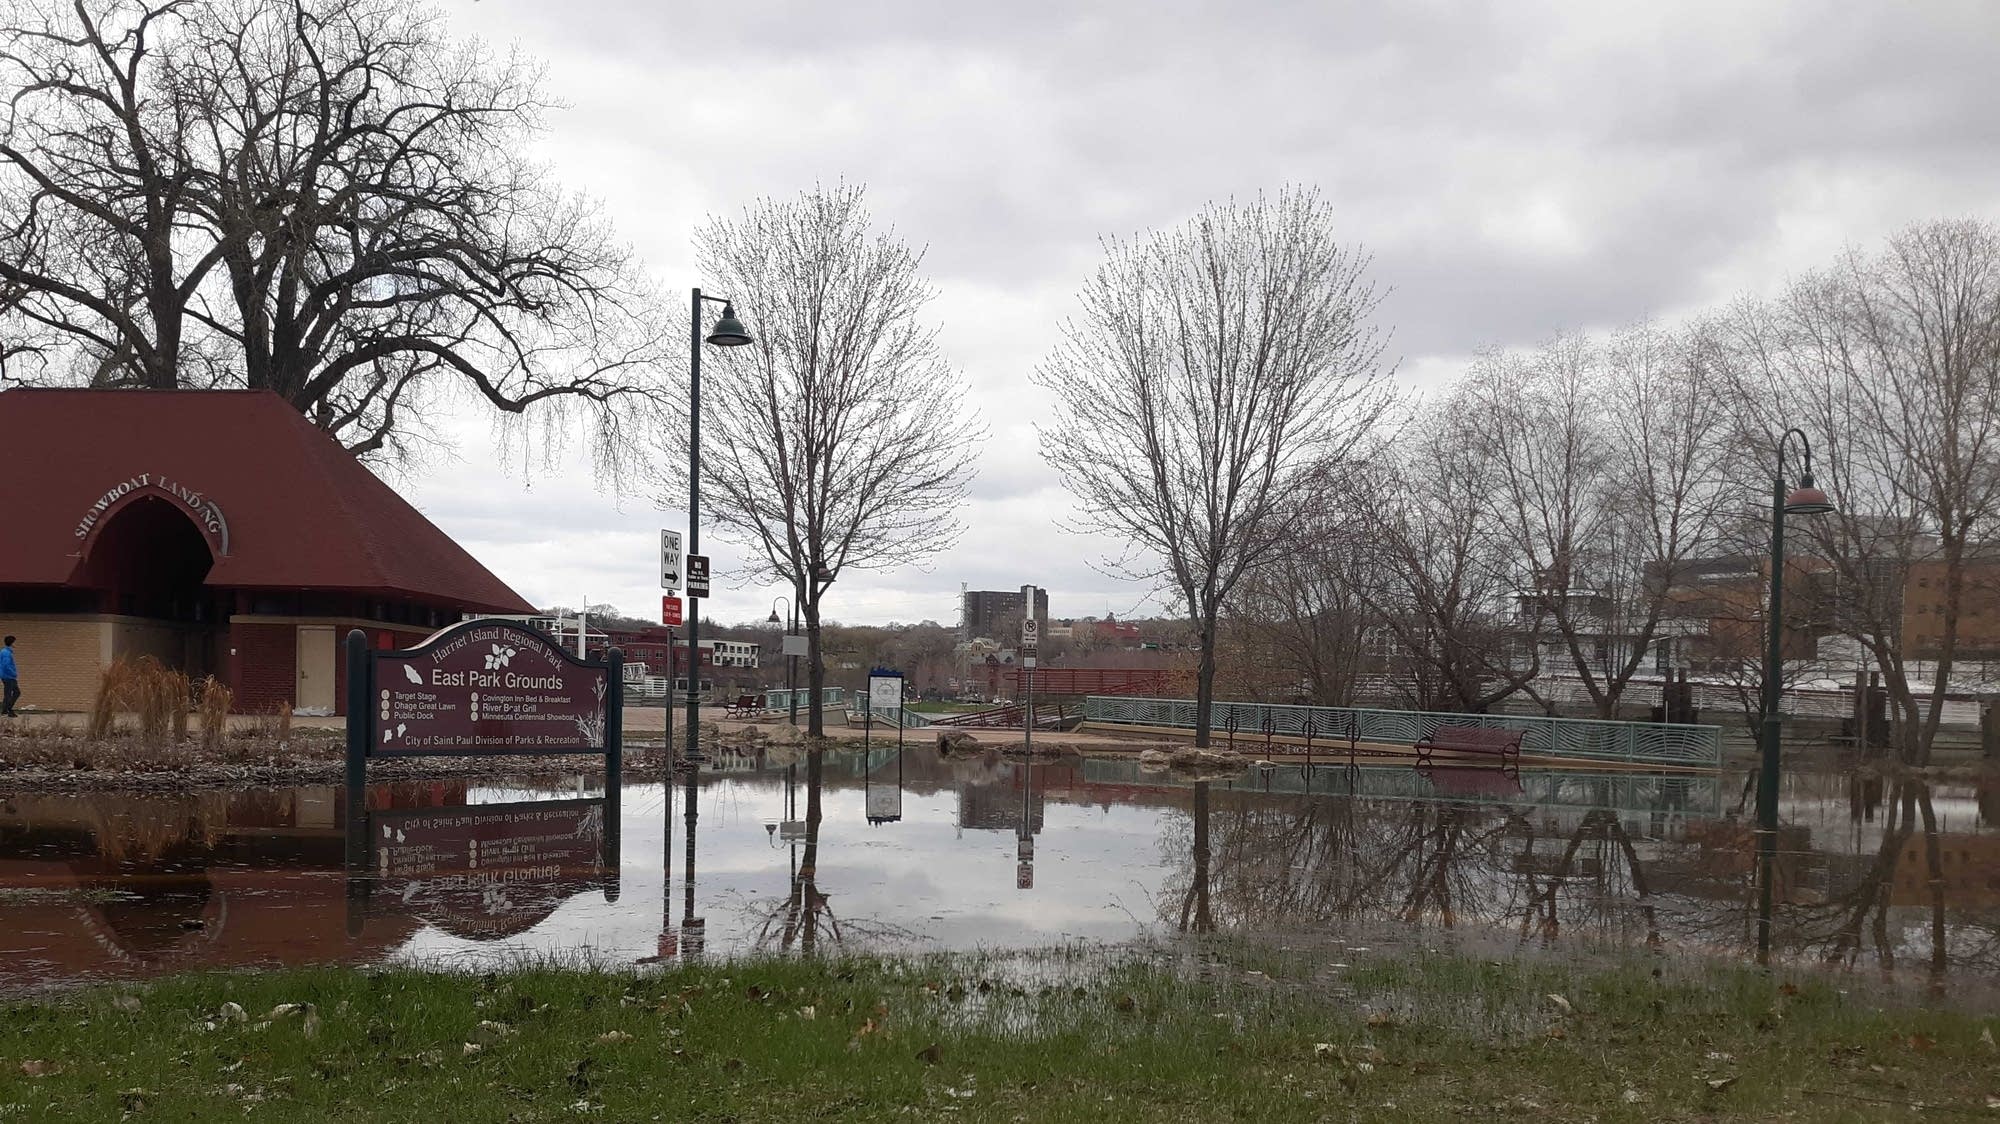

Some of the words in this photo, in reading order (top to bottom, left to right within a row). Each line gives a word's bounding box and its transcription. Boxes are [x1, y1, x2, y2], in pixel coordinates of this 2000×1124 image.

[75, 473, 150, 540] SHOWBOAT
[158, 475, 222, 533] LANDING
[664, 535, 679, 551] ONE
[664, 551, 680, 567] WAY
[687, 581, 709, 590] PARKING
[431, 636, 468, 664] Harriet
[469, 627, 499, 643] Island
[503, 628, 543, 654] Regional
[544, 648, 563, 672] Park
[432, 668, 465, 686] East
[469, 670, 501, 688] Park
[505, 672, 563, 690] Grounds
[395, 691, 416, 701] Target
[417, 692, 437, 702] Stage
[482, 694, 514, 703] Covington
[394, 701, 418, 711] Ohage
[418, 701, 437, 710] Great
[438, 702, 456, 710] Lawn
[482, 703, 501, 712] River
[522, 703, 537, 713] Grill
[393, 711, 416, 720] Public
[416, 711, 434, 720] Dock
[514, 713, 546, 721] Centennial
[405, 735, 420, 747] City
[423, 736, 431, 745] of
[433, 735, 454, 745] Saint
[456, 735, 473, 745] Paul
[475, 735, 504, 745] Division
[506, 735, 513, 744] of
[515, 735, 535, 744] Parks
[536, 735, 543, 744] &
[544, 735, 580, 744] Recreation
